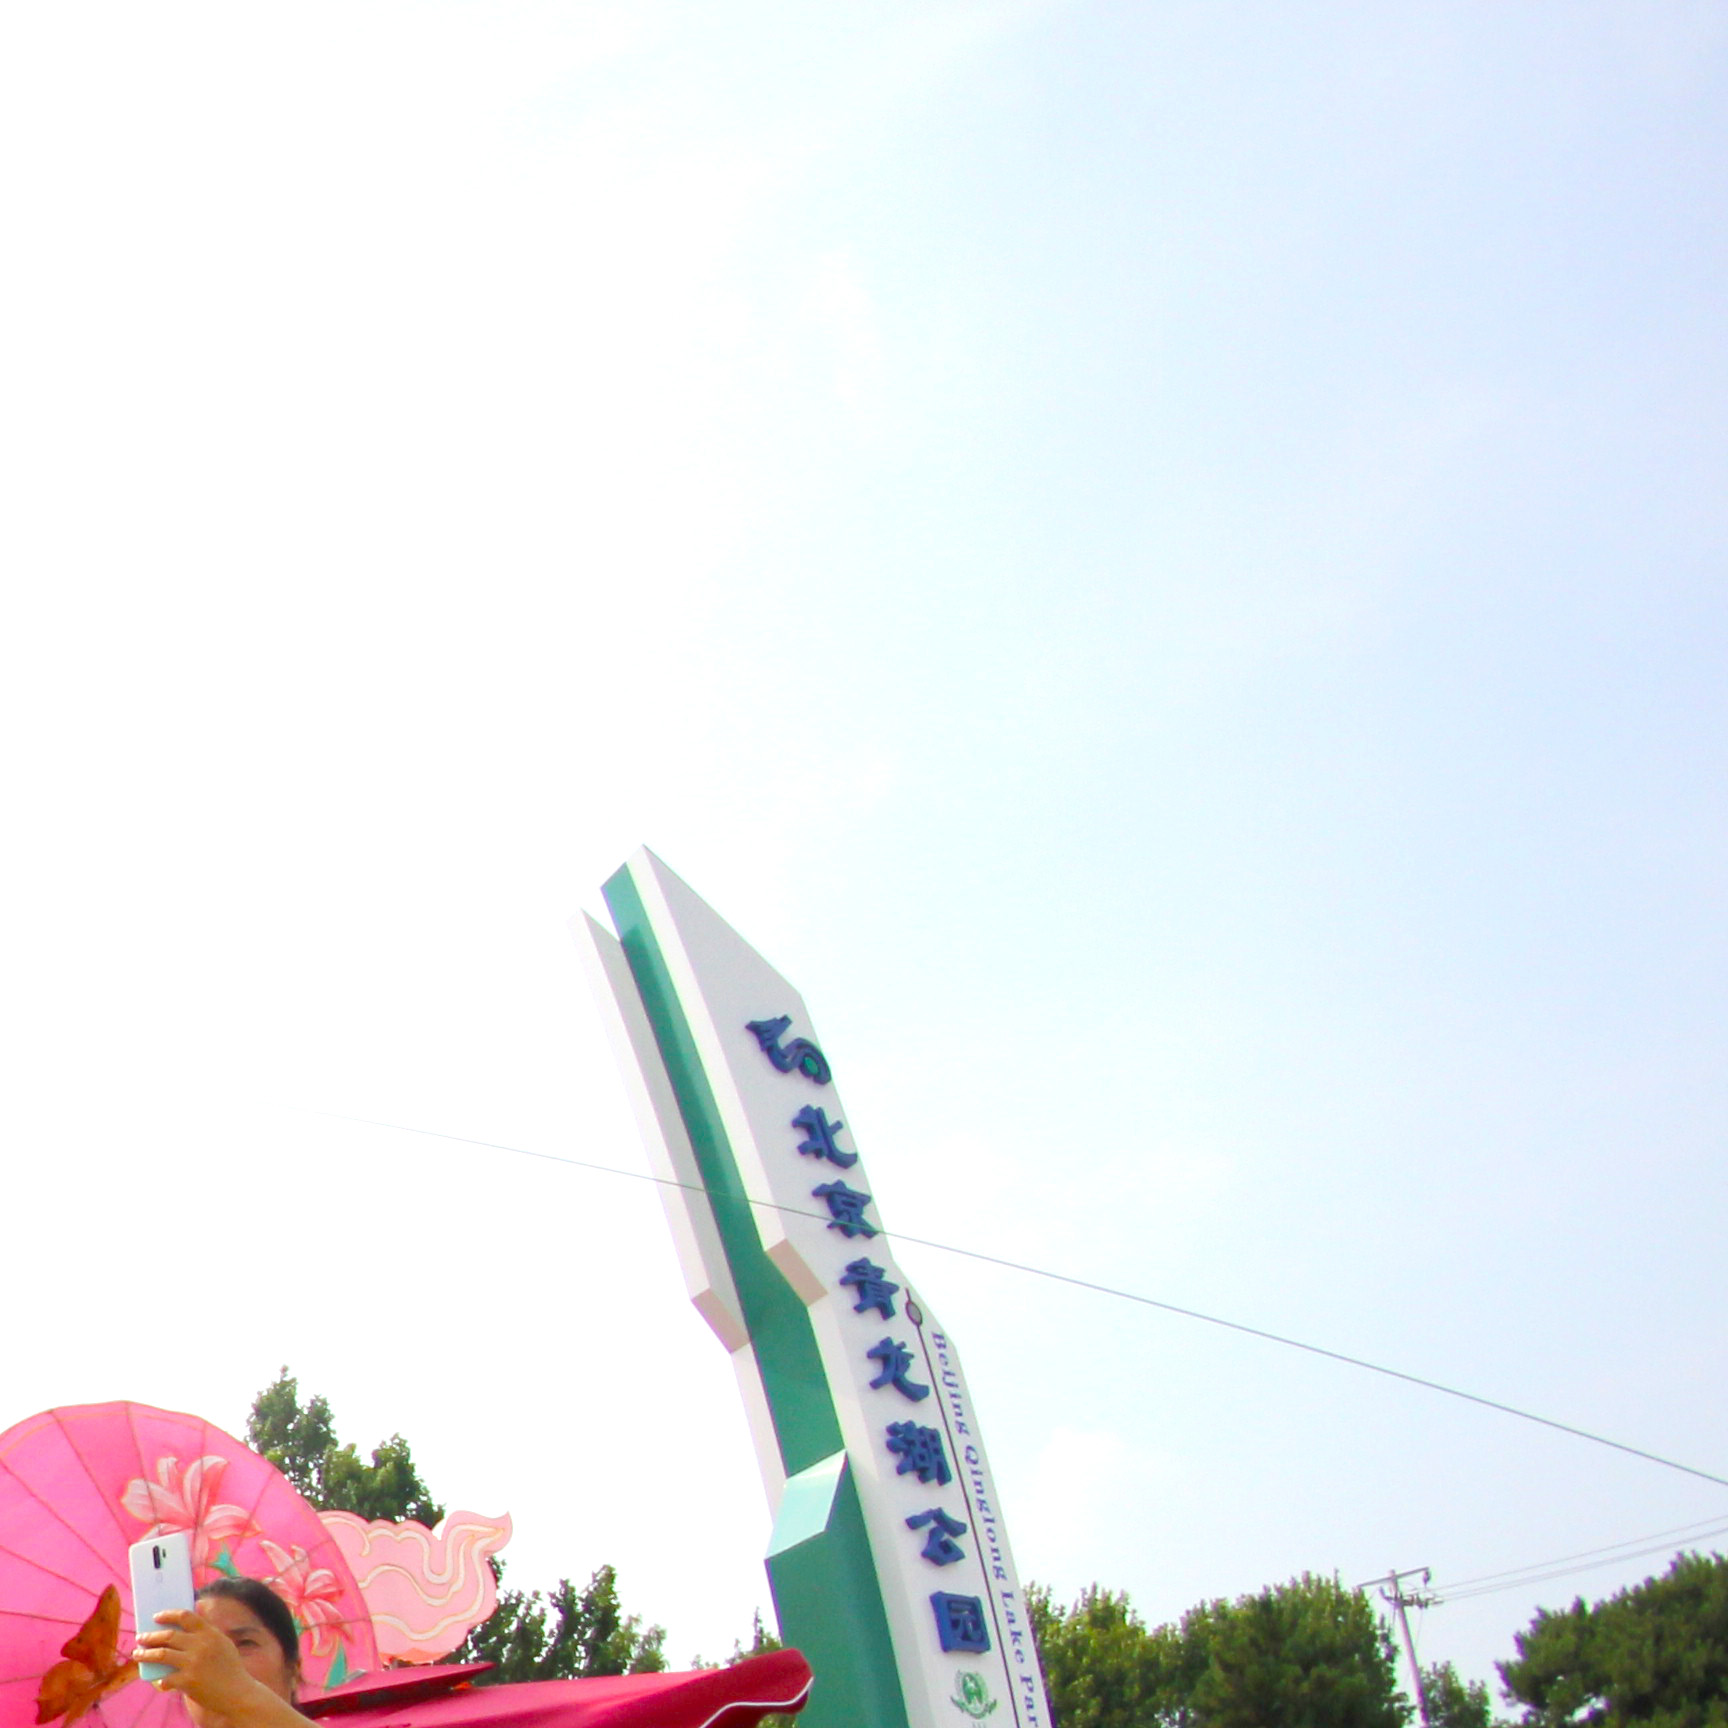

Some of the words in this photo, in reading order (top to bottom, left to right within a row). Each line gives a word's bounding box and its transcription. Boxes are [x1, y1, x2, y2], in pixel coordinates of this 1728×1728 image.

[791, 1103, 993, 1655] 北京青龙湖公园
[932, 1331, 971, 1437] Beijing
[964, 1444, 1008, 1581] Qinglong
[1000, 1588, 1025, 1665] Lake
